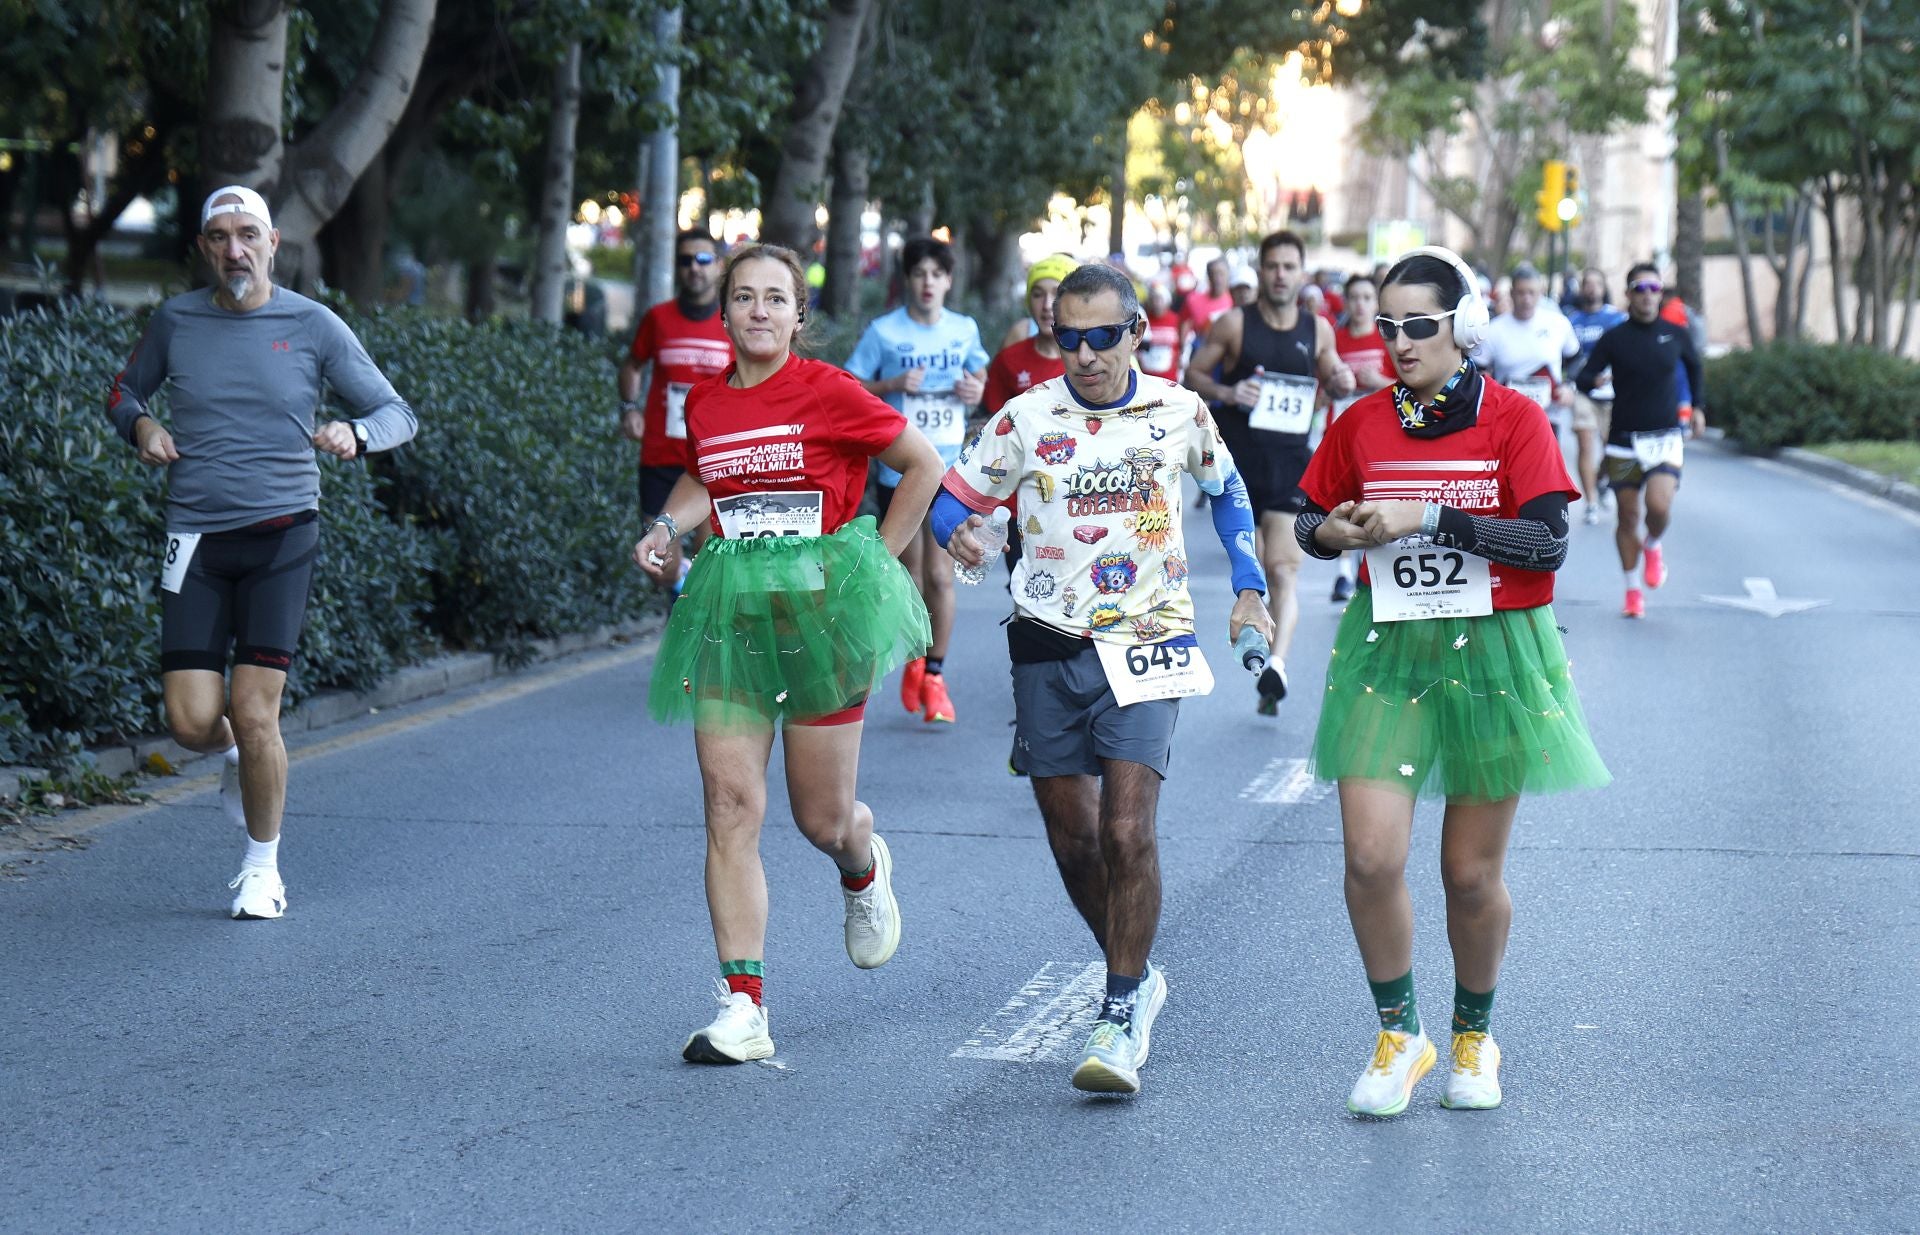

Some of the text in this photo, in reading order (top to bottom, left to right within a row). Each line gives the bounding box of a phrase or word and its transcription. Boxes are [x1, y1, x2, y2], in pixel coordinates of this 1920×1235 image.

[901, 349, 959, 370] nerja
[1267, 395, 1302, 415] 143
[916, 408, 953, 428] 939
[786, 424, 804, 435] XIV
[748, 442, 803, 456] CARRERA
[732, 451, 803, 466] SAN SILVESTRE
[1482, 460, 1499, 471] XIV
[712, 459, 804, 480] PALMA PALMILLA
[1439, 479, 1498, 490] CARRERA
[1420, 489, 1498, 499] SAN SILVESTRE
[786, 506, 818, 514] XIV
[1067, 492, 1142, 517] COLINA
[1438, 498, 1500, 509] PALMILLA
[1136, 510, 1170, 532] POOF!
[1100, 555, 1130, 568] OOF!
[1393, 552, 1468, 589] 652
[1027, 577, 1054, 597] BOOM!
[1125, 645, 1191, 676] 649
